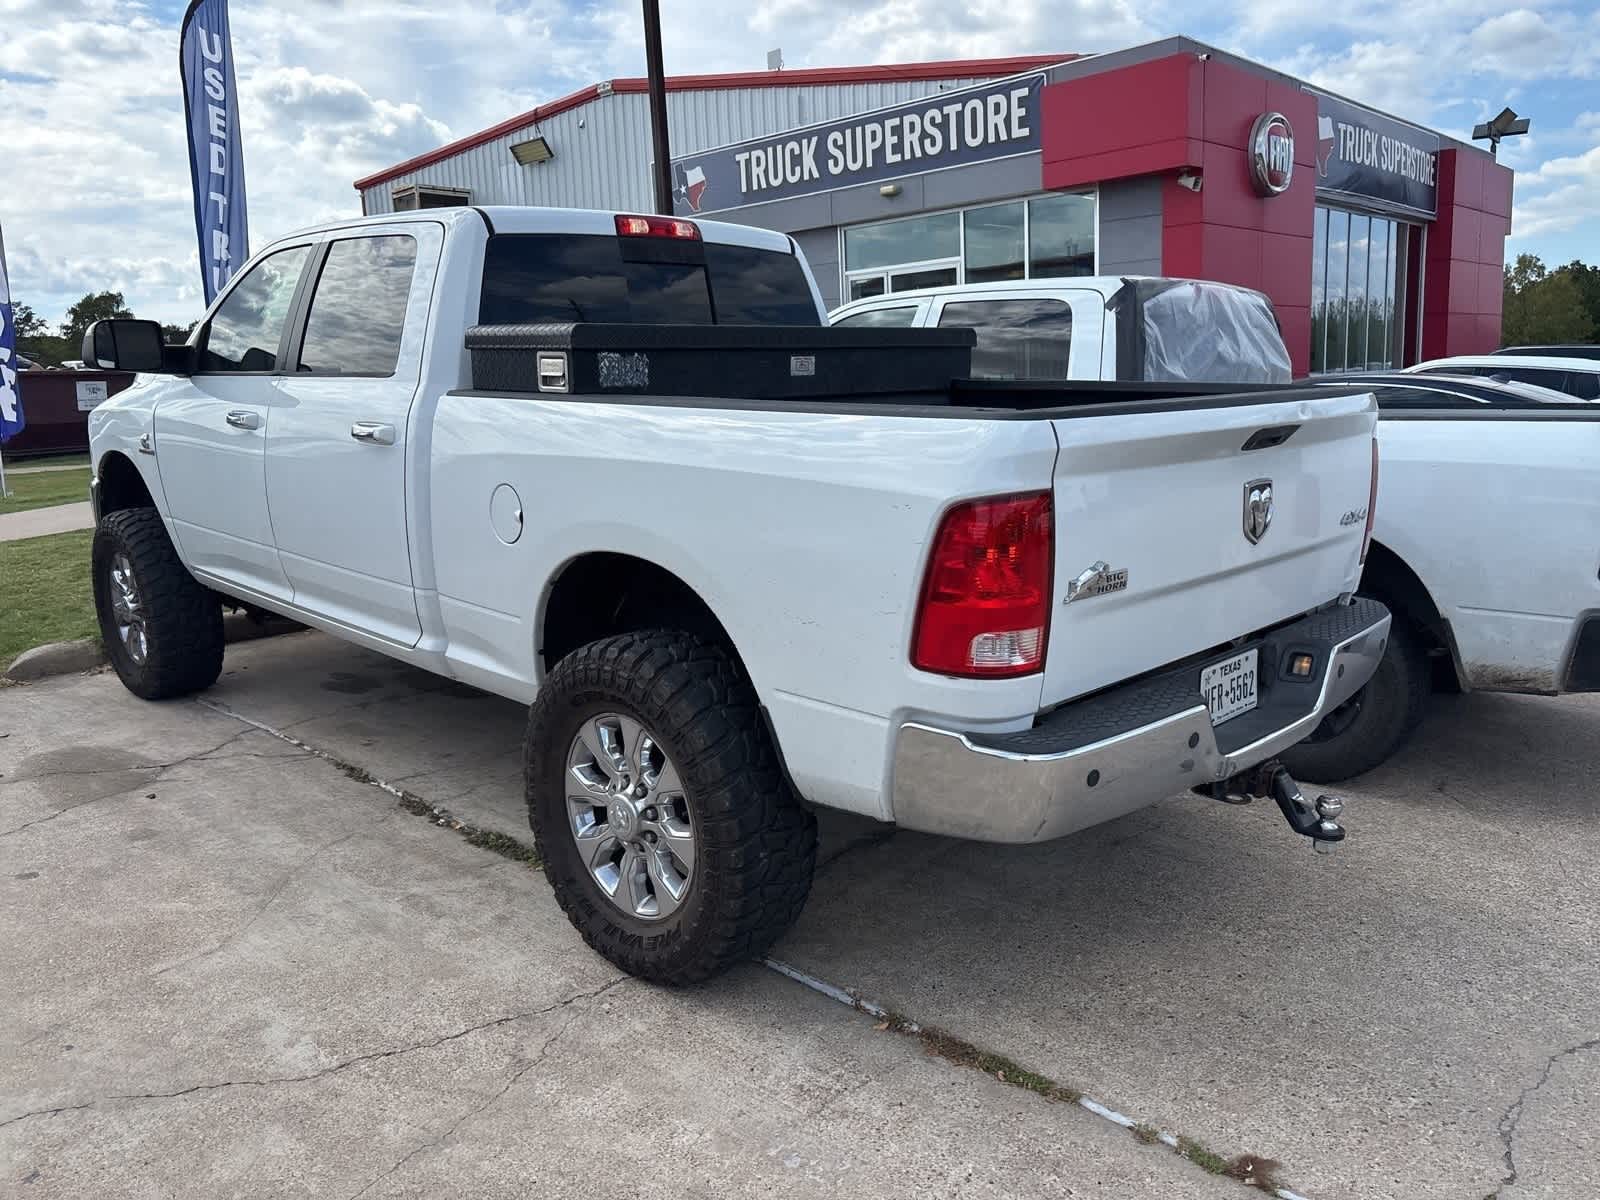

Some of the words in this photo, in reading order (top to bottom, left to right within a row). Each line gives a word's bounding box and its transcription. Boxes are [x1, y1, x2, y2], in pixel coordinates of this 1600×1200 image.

[199, 27, 226, 176] USED
[735, 136, 820, 193] TRUCK
[827, 87, 1030, 176] SUPERSTORE
[1269, 134, 1294, 172] FIAT
[1337, 122, 1379, 169] TRUCK
[1381, 135, 1436, 187] SUPERSTORE
[1097, 580, 1127, 594] HORN
[1106, 571, 1124, 583] BIG
[1220, 659, 1242, 678] TEXAS
